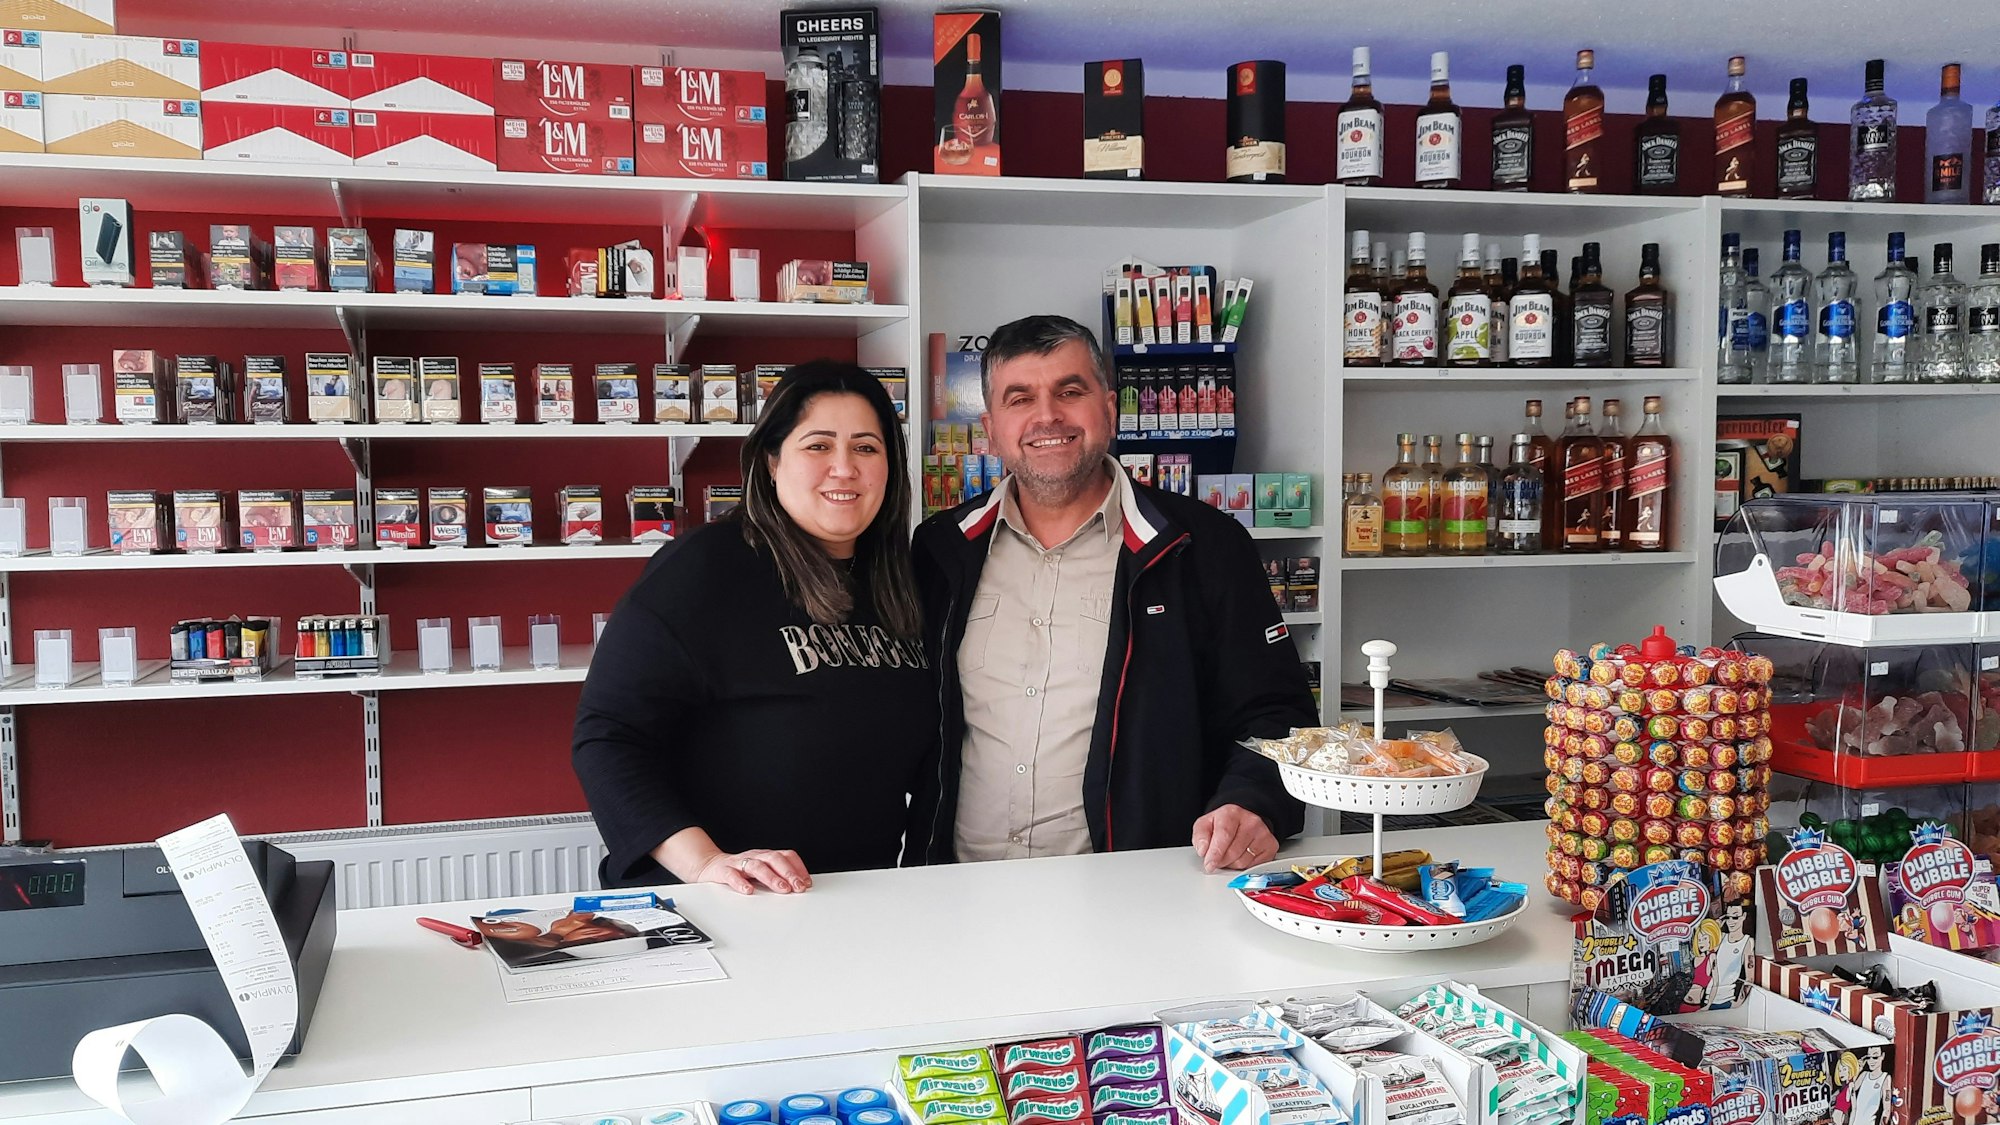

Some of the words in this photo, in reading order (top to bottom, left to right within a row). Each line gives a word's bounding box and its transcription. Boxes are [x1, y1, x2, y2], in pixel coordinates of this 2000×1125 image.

[797, 18, 864, 33] CHEERS
[807, 35, 841, 43] LEGENDARY
[842, 34, 864, 42] NIGHTS
[111, 80, 134, 88] gold
[538, 60, 585, 100] L&M
[676, 67, 721, 105] L&M
[1339, 120, 1353, 134] JIM
[1354, 117, 1376, 132] BEAM
[1418, 123, 1432, 138] JIM
[1433, 120, 1455, 135] BEAM
[1580, 117, 1602, 131] LABEL
[1729, 122, 1751, 136] LABEL
[540, 118, 586, 156] L&M
[677, 124, 722, 161] L&M
[1493, 133, 1507, 145] JACK
[1641, 138, 1656, 150] JACK
[112, 141, 135, 149] gold
[1341, 149, 1371, 160] BOURBON
[1419, 152, 1450, 163] BOURBON
[83, 201, 100, 214] glo
[84, 258, 97, 267] air
[1345, 303, 1357, 316] JIM
[1358, 299, 1379, 314] BEAM
[1397, 303, 1408, 316] JIM
[1410, 300, 1431, 314] BEAM
[1450, 306, 1463, 318] JIM
[1464, 302, 1486, 316] BEAM
[1513, 304, 1527, 317] JIM
[1528, 301, 1550, 315] BEAM
[1575, 310, 1588, 321] JACK
[1627, 313, 1641, 322] JACK
[1348, 328, 1373, 337] HONEY
[1411, 329, 1432, 337] CHERRY
[1456, 330, 1478, 339] APPLE
[1515, 332, 1546, 341] BOURBON
[1718, 419, 1785, 438] germeister
[1581, 468, 1602, 480] LABEL
[1642, 468, 1666, 479] LABEL
[1386, 480, 1425, 489] ABSOLUT
[1447, 480, 1487, 490] ABSOLUT
[133, 528, 152, 543] L&M
[197, 527, 216, 542] L&M
[267, 526, 288, 541] L&M
[390, 530, 416, 539] Winston
[437, 526, 460, 534] West
[498, 525, 521, 533] West
[1793, 837, 1821, 849] ORIGINAL
[194, 854, 244, 877] OLYMPIA
[1781, 852, 1845, 882] DUBBLE
[1904, 847, 1965, 877] DUBBLE
[1654, 874, 1681, 885] ORIGINAL
[1786, 868, 1852, 898] BUBBLE
[1909, 862, 1970, 894] BUBBLE
[1637, 888, 1698, 914] DUBBLE
[1801, 897, 1826, 911] BUBBLE
[1826, 894, 1844, 905] GUM
[1923, 891, 1945, 907] BUBBLE
[1945, 890, 1962, 901] GUM
[1640, 902, 1701, 930] BUBBLE
[1648, 927, 1671, 941] BUBBLE
[1671, 925, 1689, 936] GUM
[1582, 935, 1596, 962] 2
[1595, 936, 1624, 948] BUBBLE
[1600, 945, 1618, 956] GUM
[1595, 949, 1656, 983] MEGA
[1606, 971, 1646, 987] TATTOO
[250, 985, 295, 999] OLYMPIA
[1091, 1033, 1154, 1052] Airwaves
[1005, 1043, 1072, 1063] Airwaves
[910, 1055, 978, 1073] Airwaves
[1094, 1058, 1156, 1078] Airwaves
[1224, 1058, 1263, 1069] SHERMAN'S
[1263, 1056, 1290, 1065] FRIEND
[1009, 1069, 1075, 1091] Airwaves
[1782, 1064, 1793, 1085] 2
[1792, 1069, 1818, 1080] BUBBLE
[1796, 1077, 1812, 1087] GUM
[917, 1078, 985, 1096] Airwaves
[1096, 1084, 1159, 1105] Airwaves
[1265, 1091, 1297, 1100] ERMAN'S
[1297, 1089, 1323, 1097] FRIEND
[1420, 1086, 1447, 1098] FRIEND
[1271, 1099, 1312, 1108] EUCALYPTUS
[1400, 1098, 1439, 1111] EUCALYPTUS
[1711, 1094, 1760, 1116] DUBBLE
[1781, 1084, 1831, 1111] MEGA
[924, 1101, 993, 1119] Airwaves
[1013, 1096, 1080, 1118] Airwaves
[1790, 1101, 1823, 1114] TATTOO
[1713, 1107, 1761, 1125] BUBBLE
